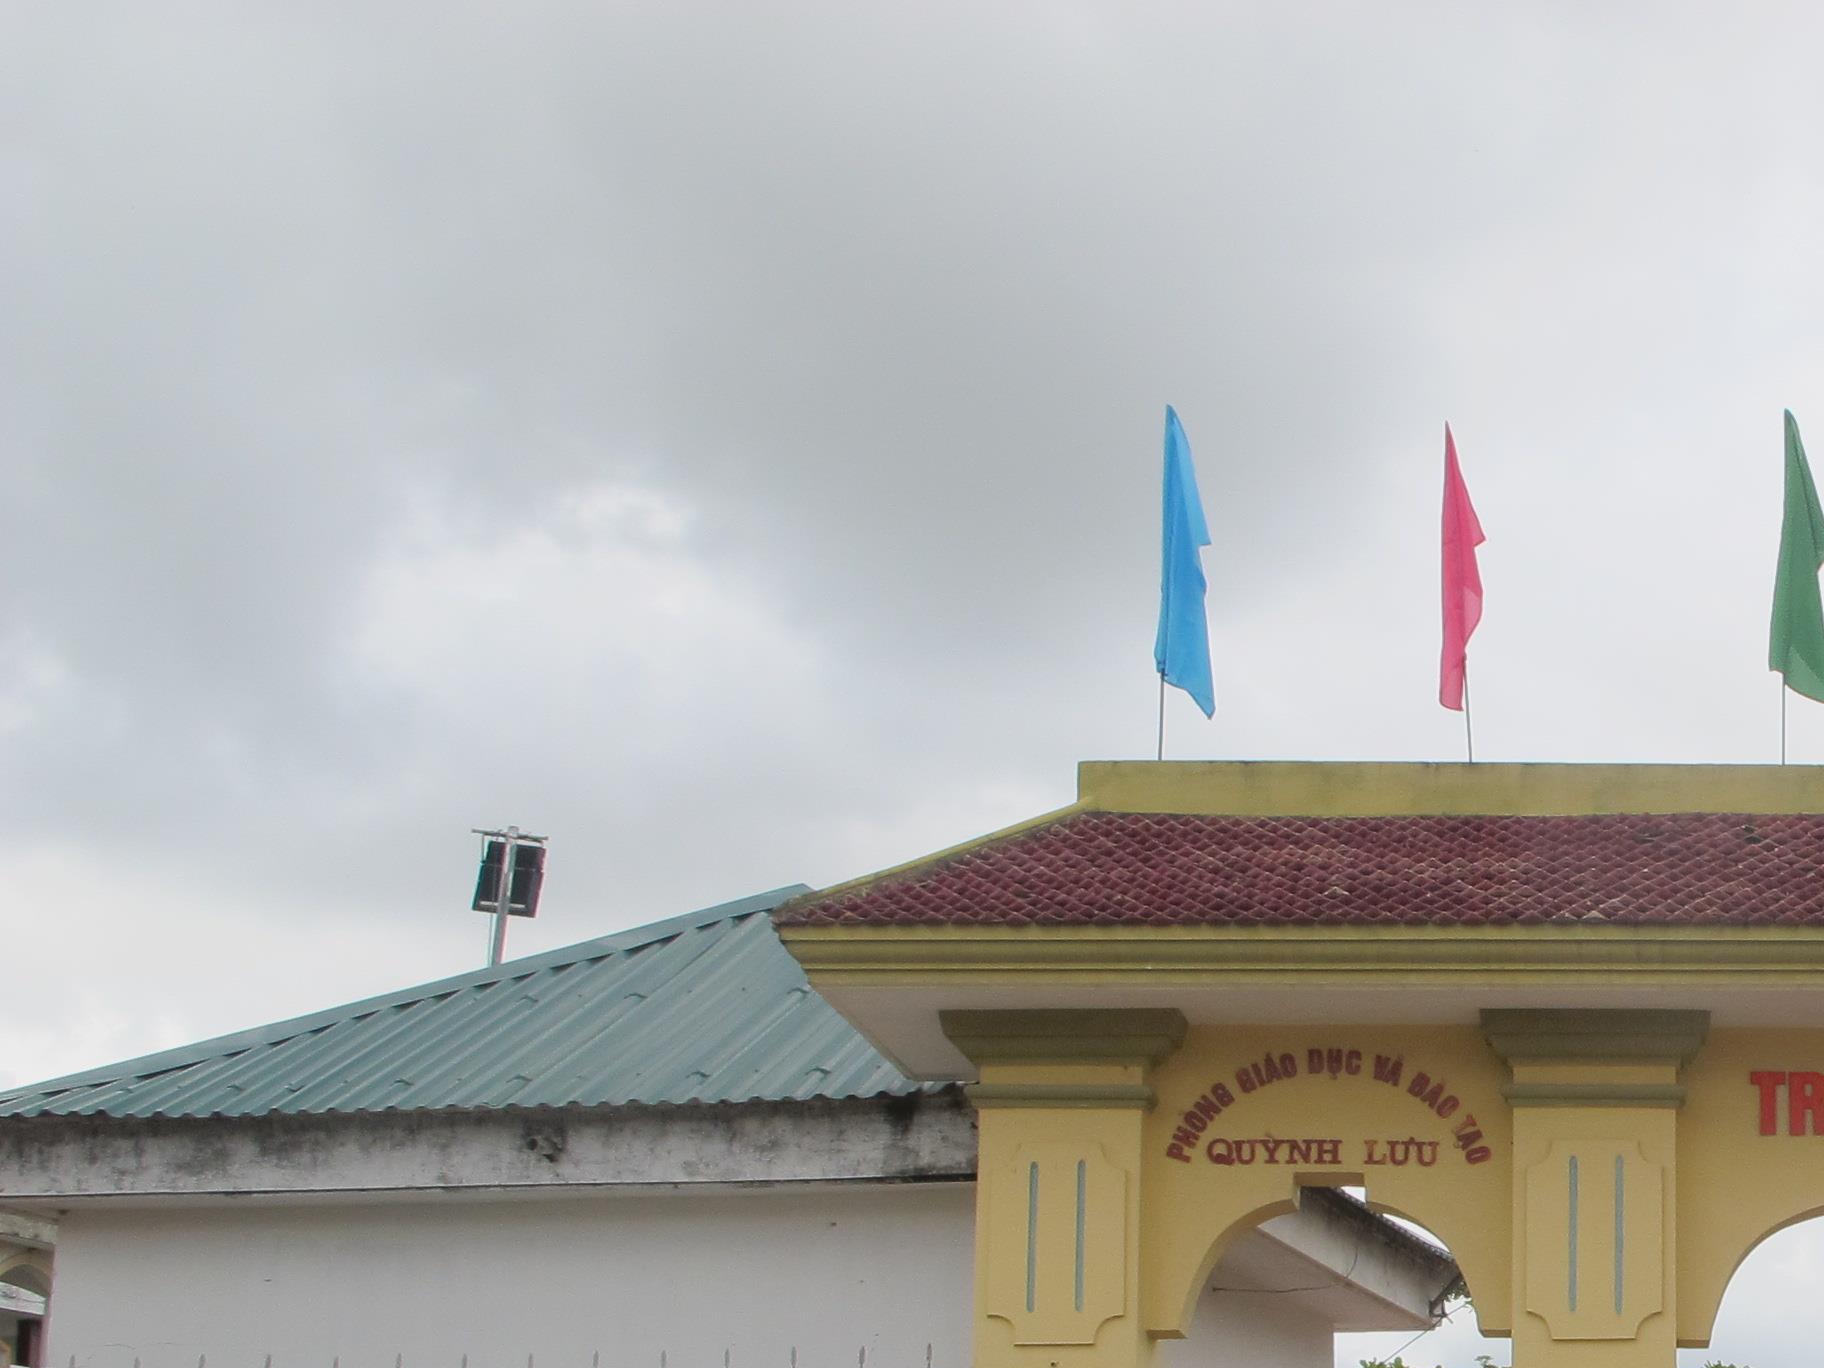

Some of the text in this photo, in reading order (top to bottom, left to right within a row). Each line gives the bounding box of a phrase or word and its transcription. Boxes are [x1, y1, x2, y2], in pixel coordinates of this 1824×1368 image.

[1235, 1051, 1298, 1094] GIÁO
[1307, 1048, 1363, 1080] DỤC
[1452, 1113, 1492, 1165] TẠO
[1206, 1133, 1440, 1167] QUỲNH LƯU
